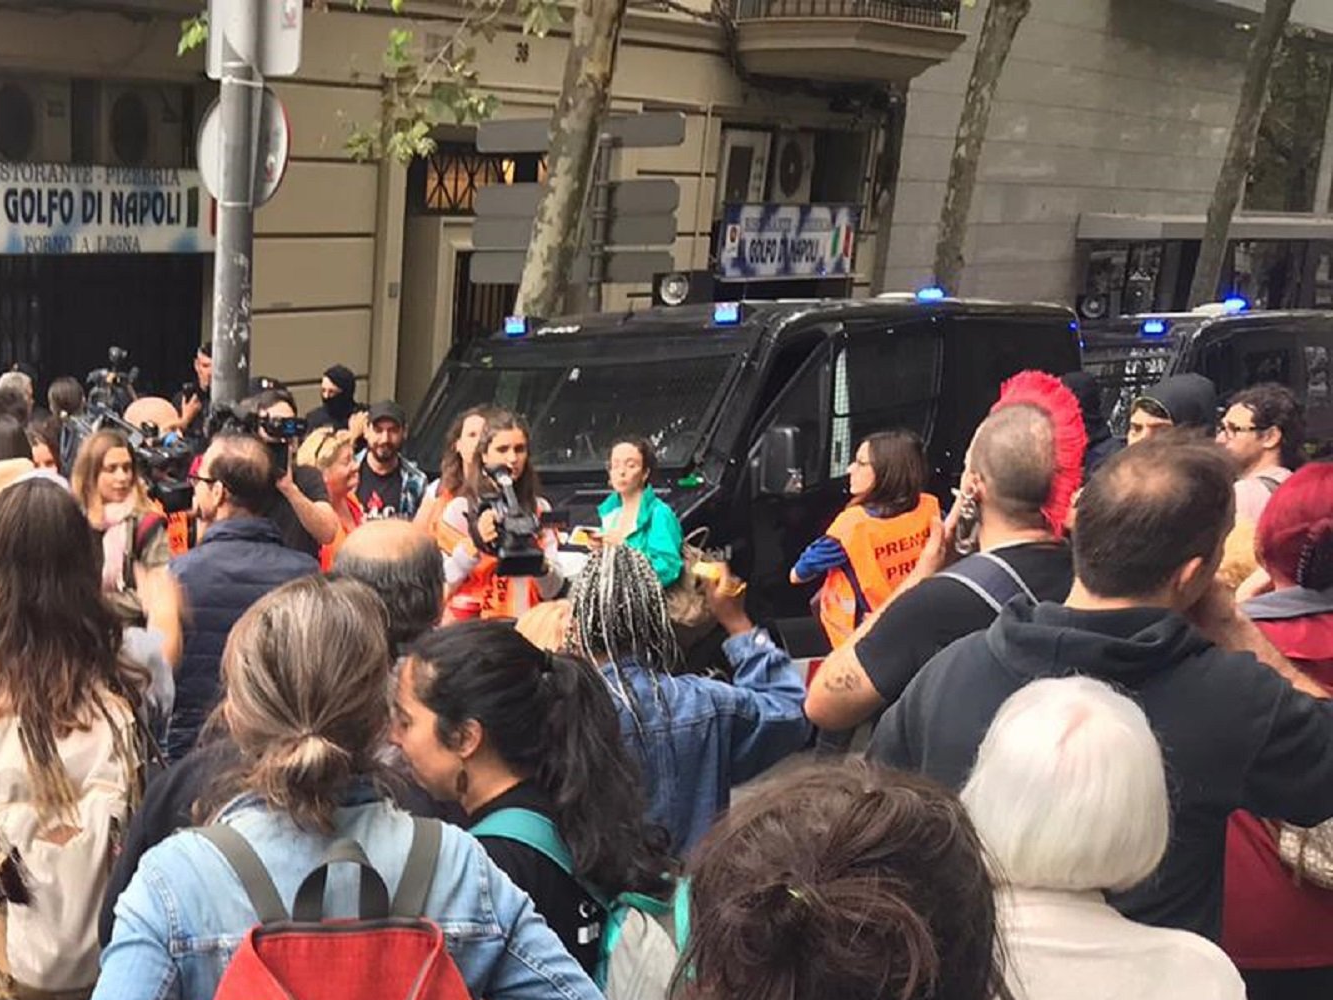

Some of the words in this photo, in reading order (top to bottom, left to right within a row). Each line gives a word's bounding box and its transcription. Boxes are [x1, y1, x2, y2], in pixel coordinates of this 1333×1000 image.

[4, 188, 75, 228] GOLFO
[81, 190, 103, 225] DI
[110, 191, 181, 228] NAPOLI
[24, 235, 73, 254] FORNO
[80, 237, 91, 254] A
[96, 236, 142, 254] LEGNA
[749, 239, 777, 264] GOLFO
